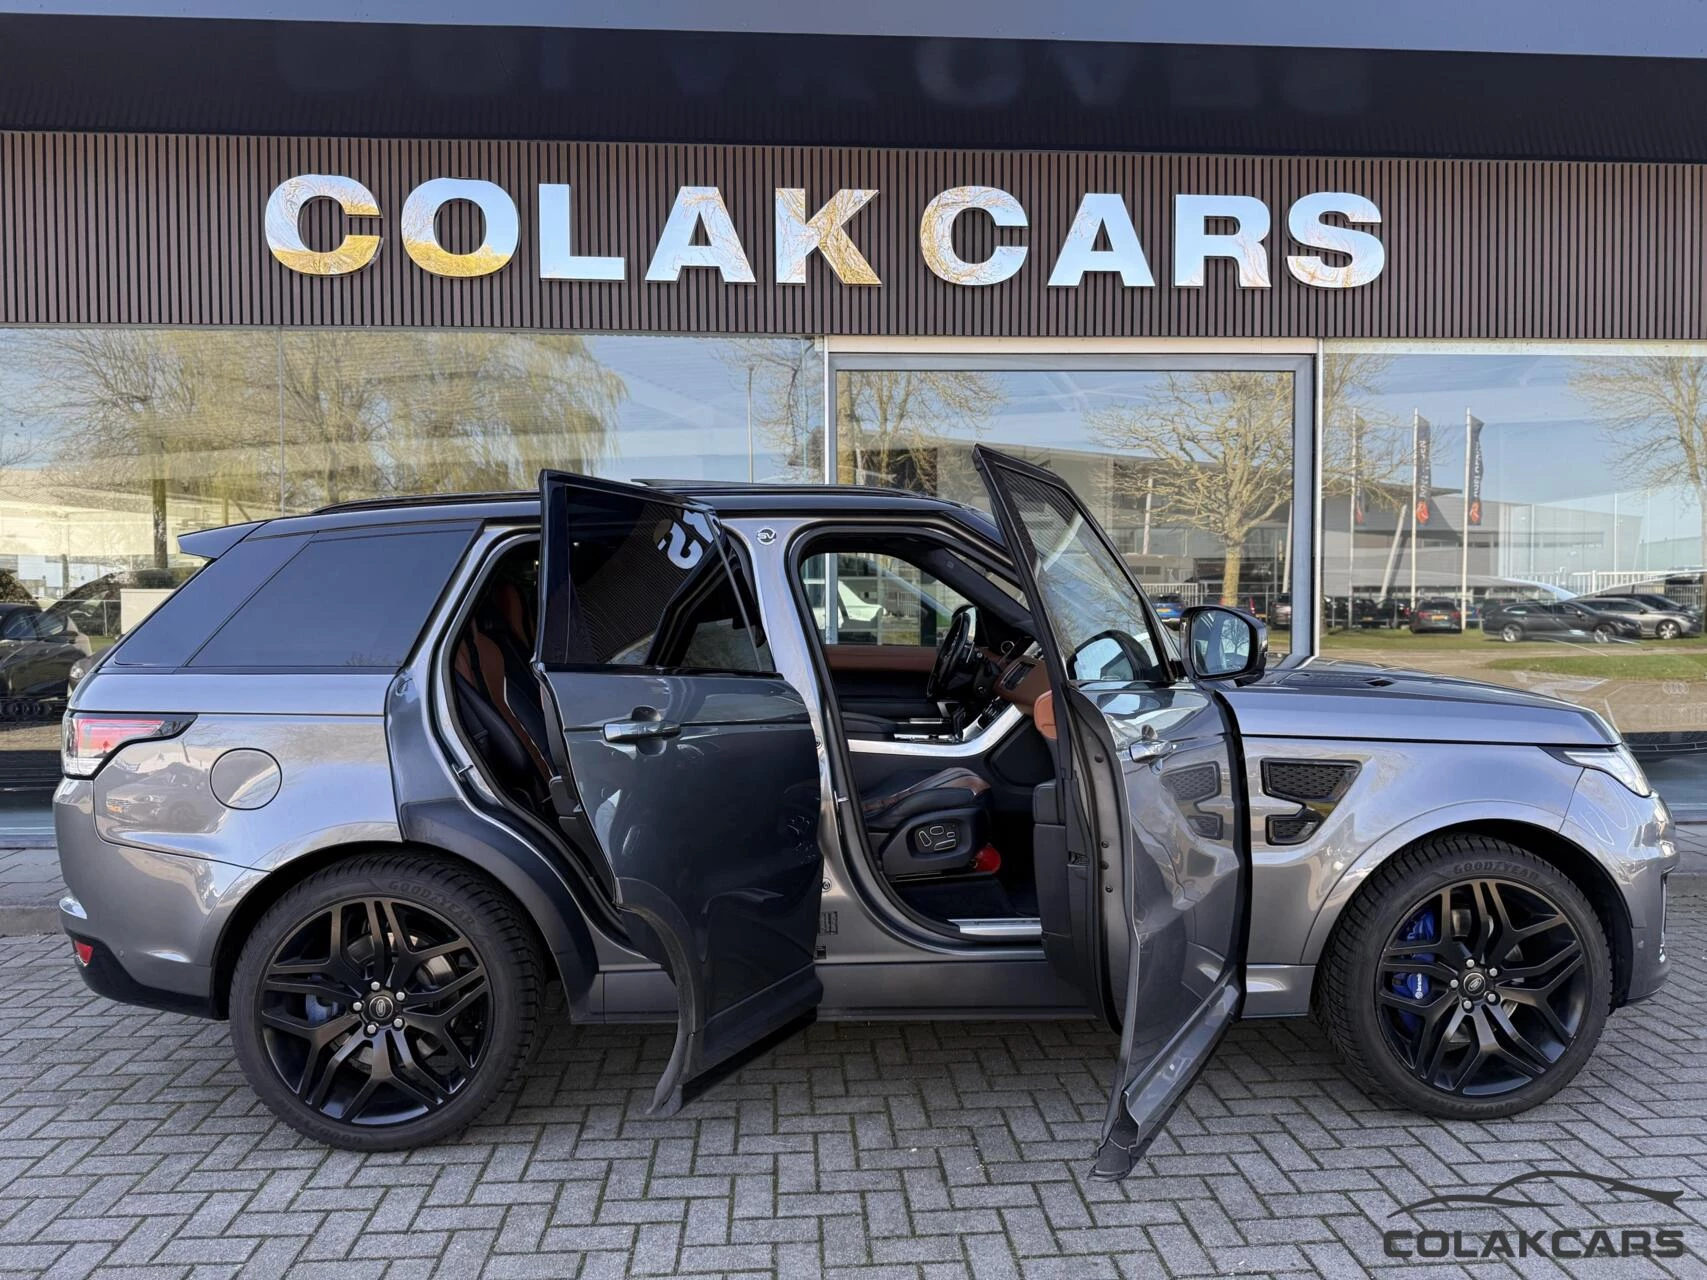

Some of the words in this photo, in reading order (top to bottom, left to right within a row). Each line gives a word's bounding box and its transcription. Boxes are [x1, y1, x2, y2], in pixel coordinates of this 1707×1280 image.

[265, 174, 882, 286] COLAK
[920, 185, 1386, 289] CARS
[1454, 861, 1541, 880] GOODYEAR
